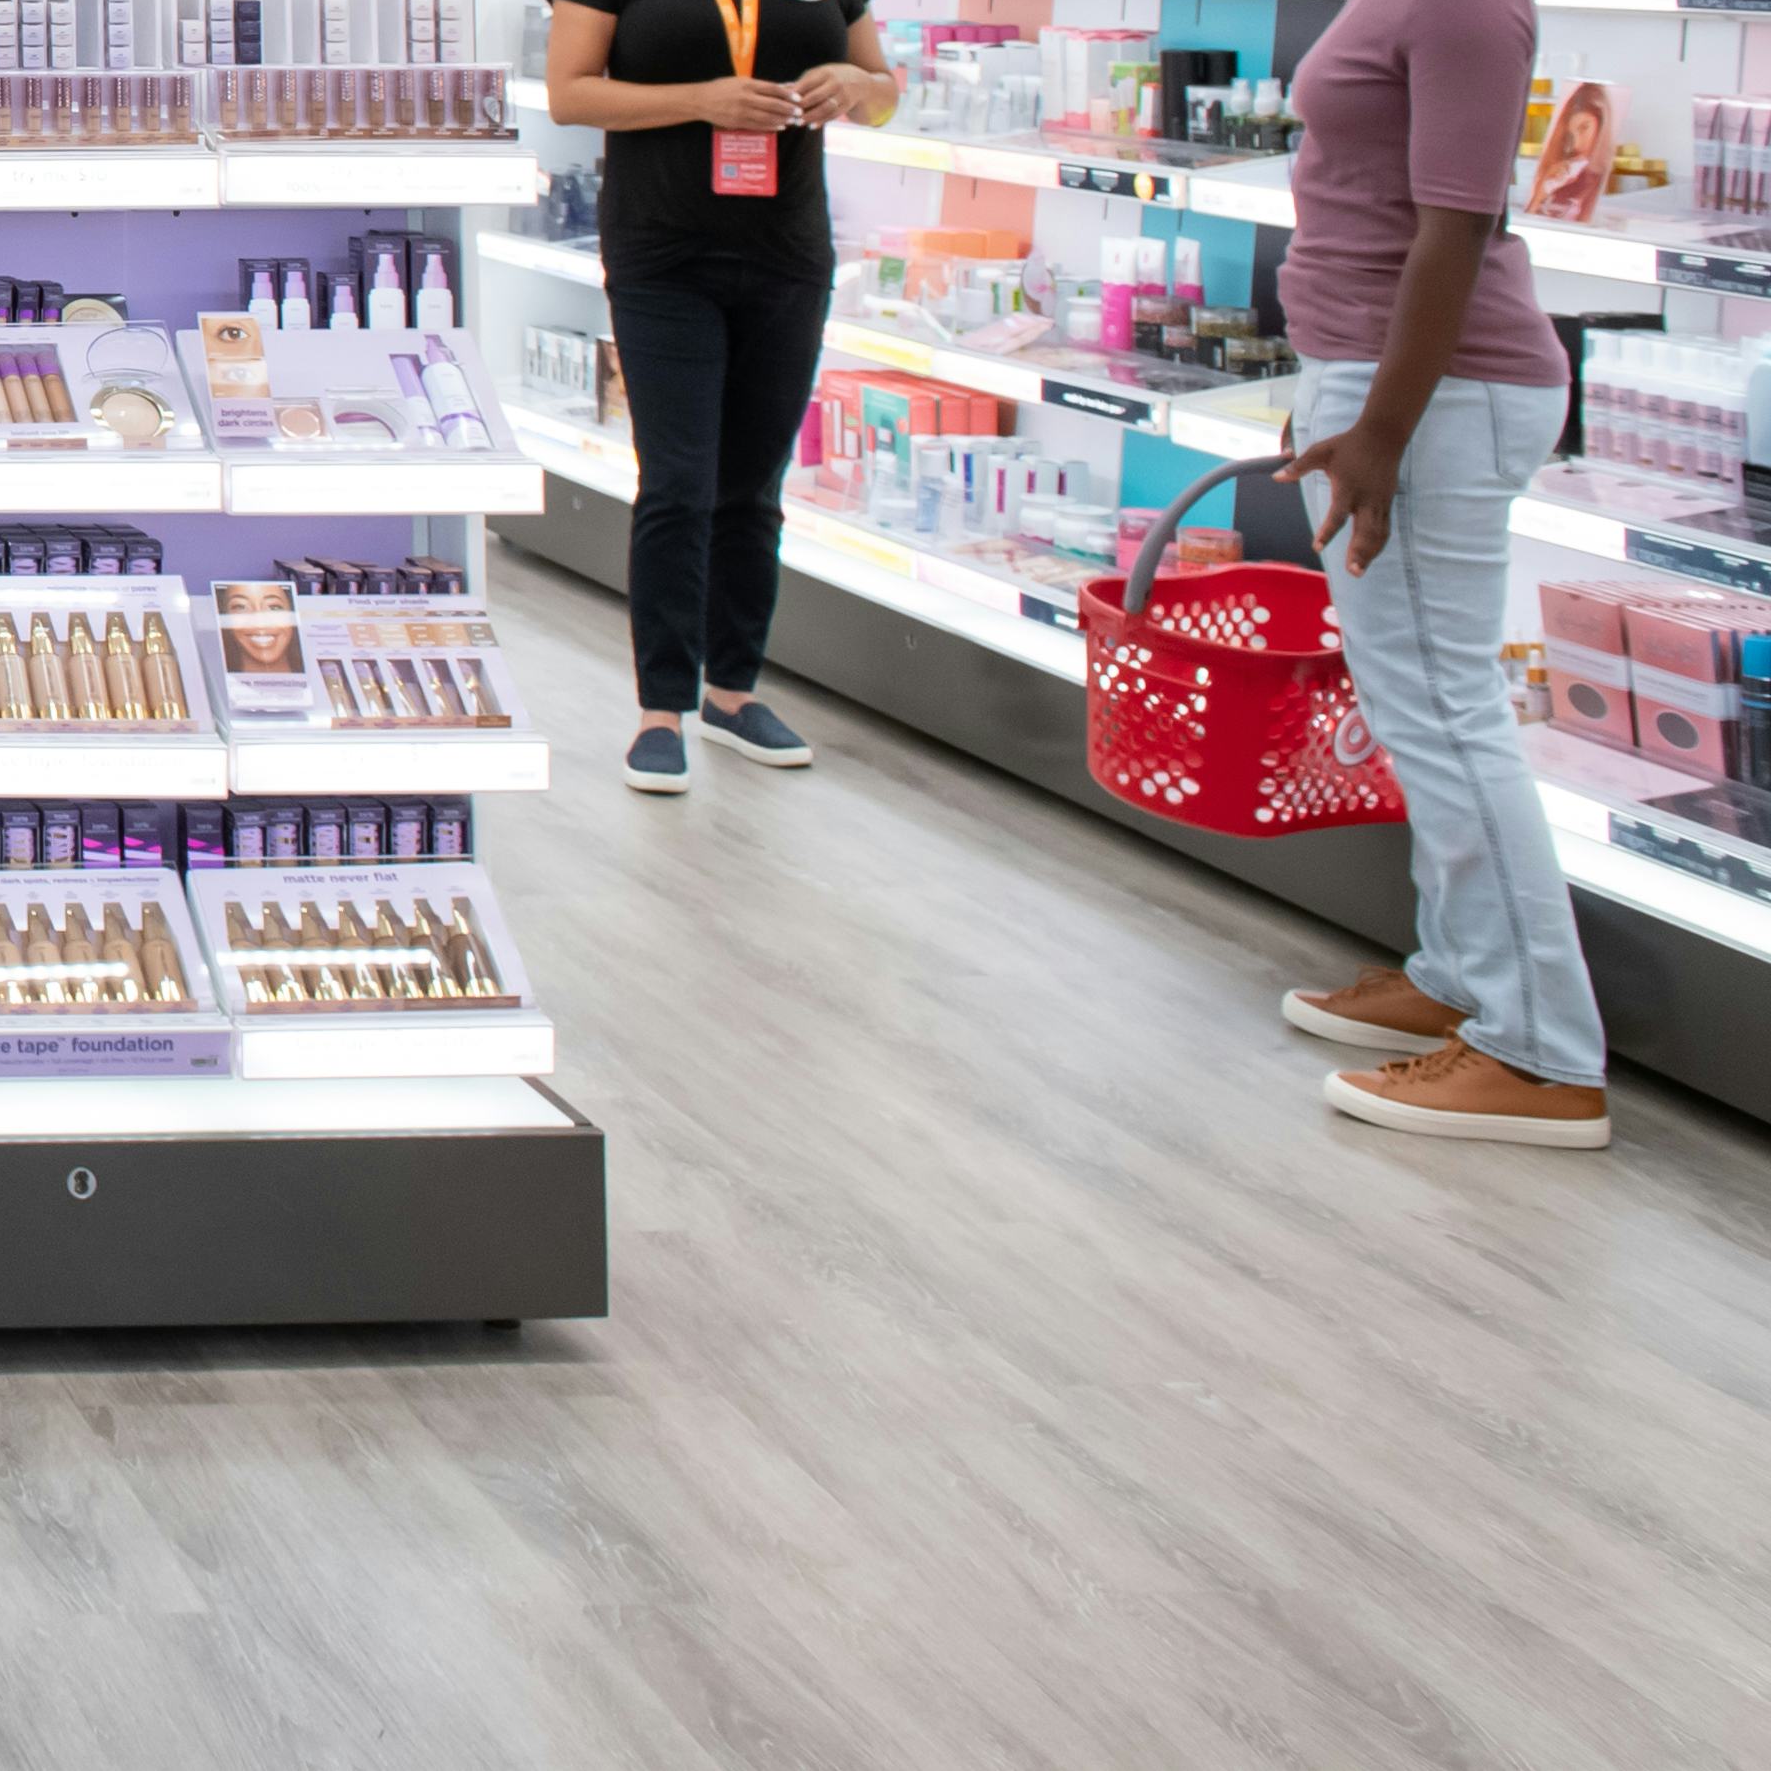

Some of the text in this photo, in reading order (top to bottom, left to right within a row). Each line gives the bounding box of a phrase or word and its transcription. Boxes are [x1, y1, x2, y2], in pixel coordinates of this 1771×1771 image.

[221, 408, 268, 418] brightens
[218, 418, 274, 428] dark circles
[283, 871, 399, 884] matte never flat
[71, 1037, 175, 1054] foundation
